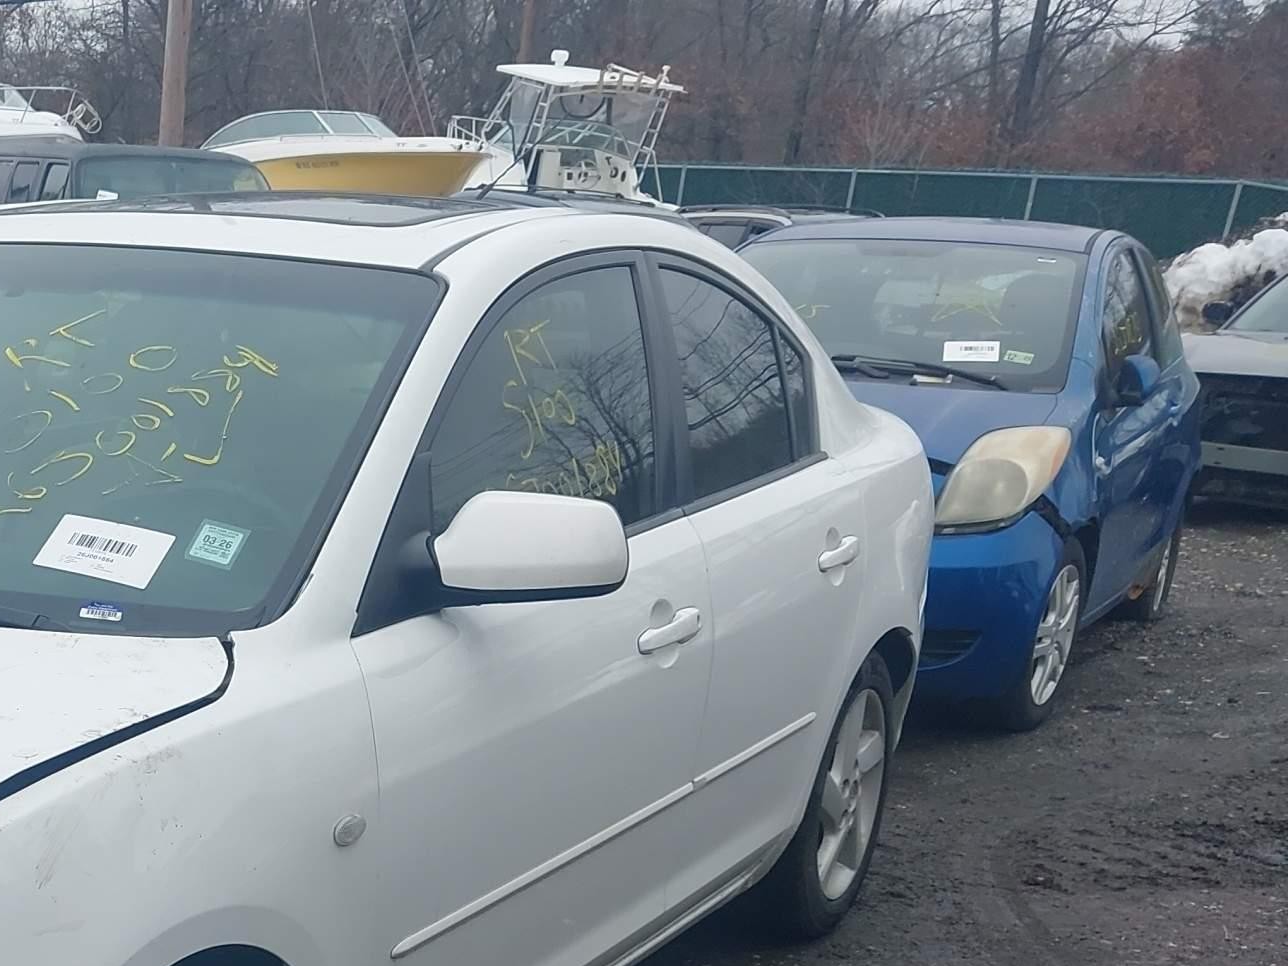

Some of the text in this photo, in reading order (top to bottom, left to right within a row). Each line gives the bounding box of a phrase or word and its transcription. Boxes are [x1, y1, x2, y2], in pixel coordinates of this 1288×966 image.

[503, 319, 558, 385] RT
[202, 534, 234, 549] 03 26
